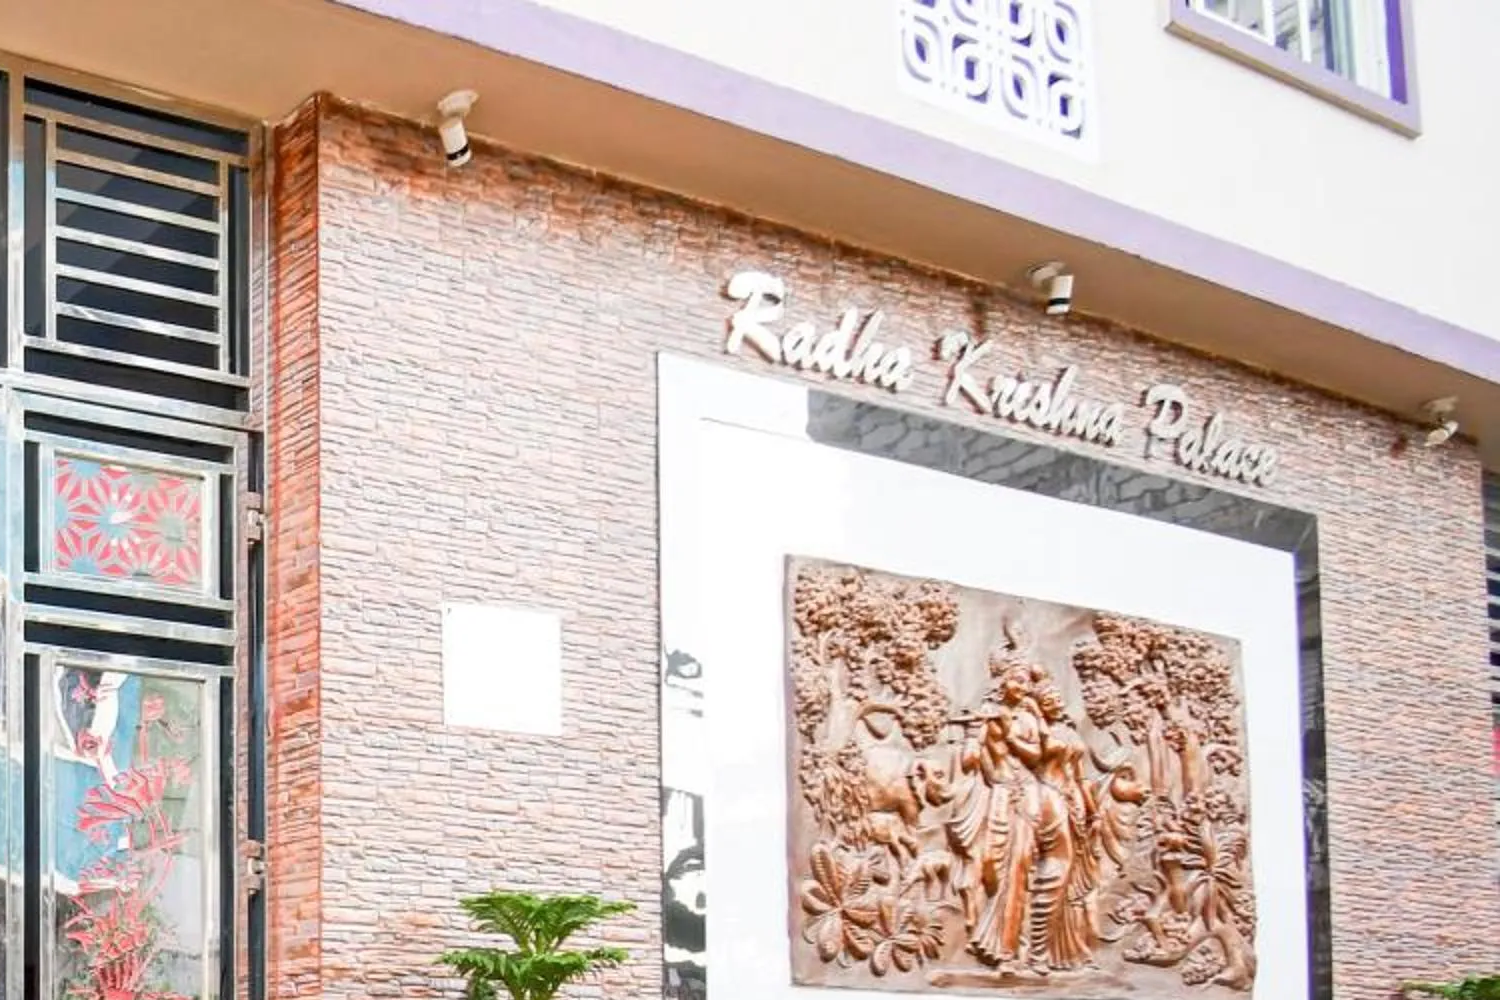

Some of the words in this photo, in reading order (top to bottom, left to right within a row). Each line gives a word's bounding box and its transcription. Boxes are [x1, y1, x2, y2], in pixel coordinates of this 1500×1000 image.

[725, 270, 915, 391] Radha
[937, 330, 1125, 446] Krishna
[1144, 383, 1276, 486] Palace
